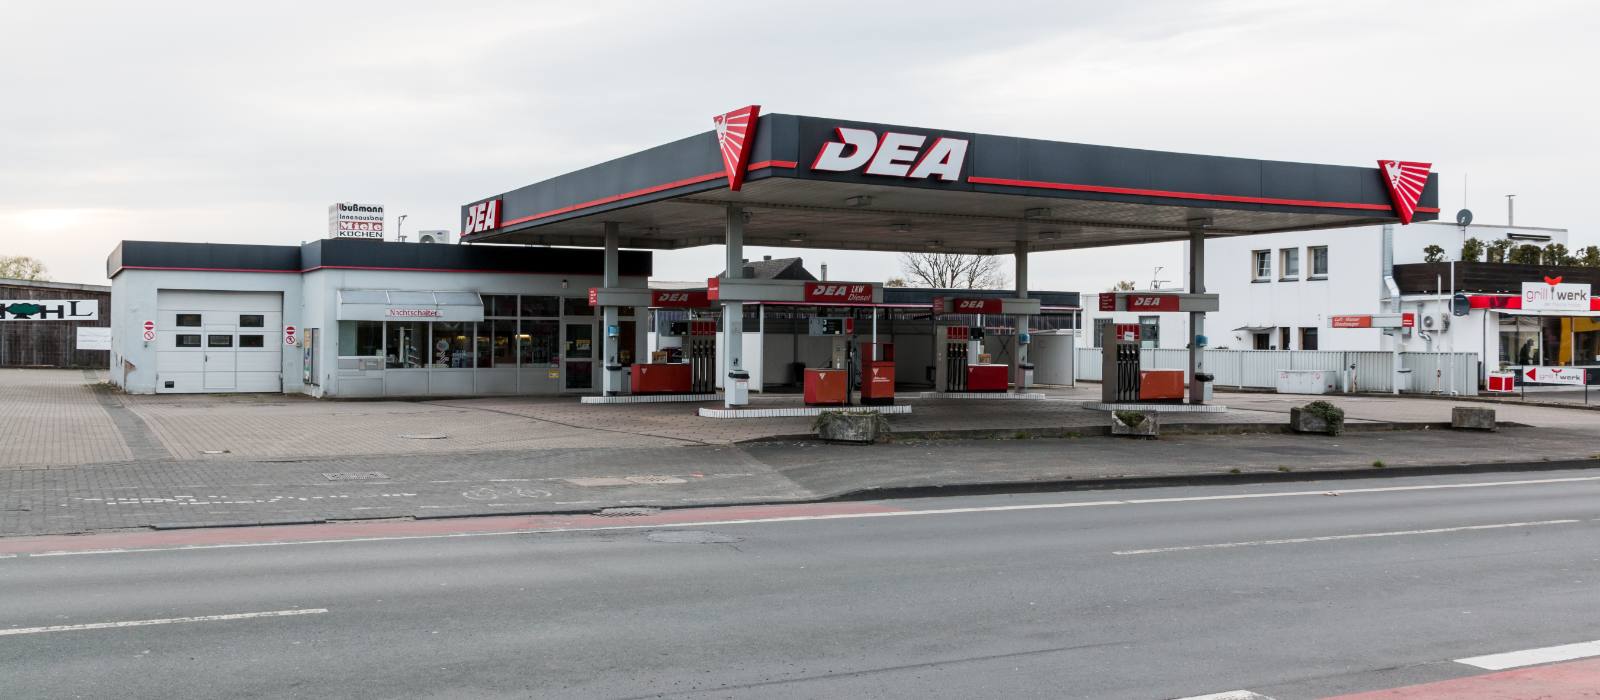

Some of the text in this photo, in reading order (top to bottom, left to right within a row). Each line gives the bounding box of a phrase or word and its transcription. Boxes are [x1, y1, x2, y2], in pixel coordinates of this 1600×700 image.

[810, 127, 969, 182] DEA
[464, 199, 499, 235] DEA
[340, 221, 383, 231] Miele
[339, 230, 383, 238] KÜCHEN
[812, 284, 865, 296] DEA LKW
[1526, 287, 1587, 303] grill werk
[658, 293, 689, 302] DEA
[847, 293, 871, 302] Diesel
[1134, 296, 1161, 306] DEA
[959, 300, 985, 309] DEA
